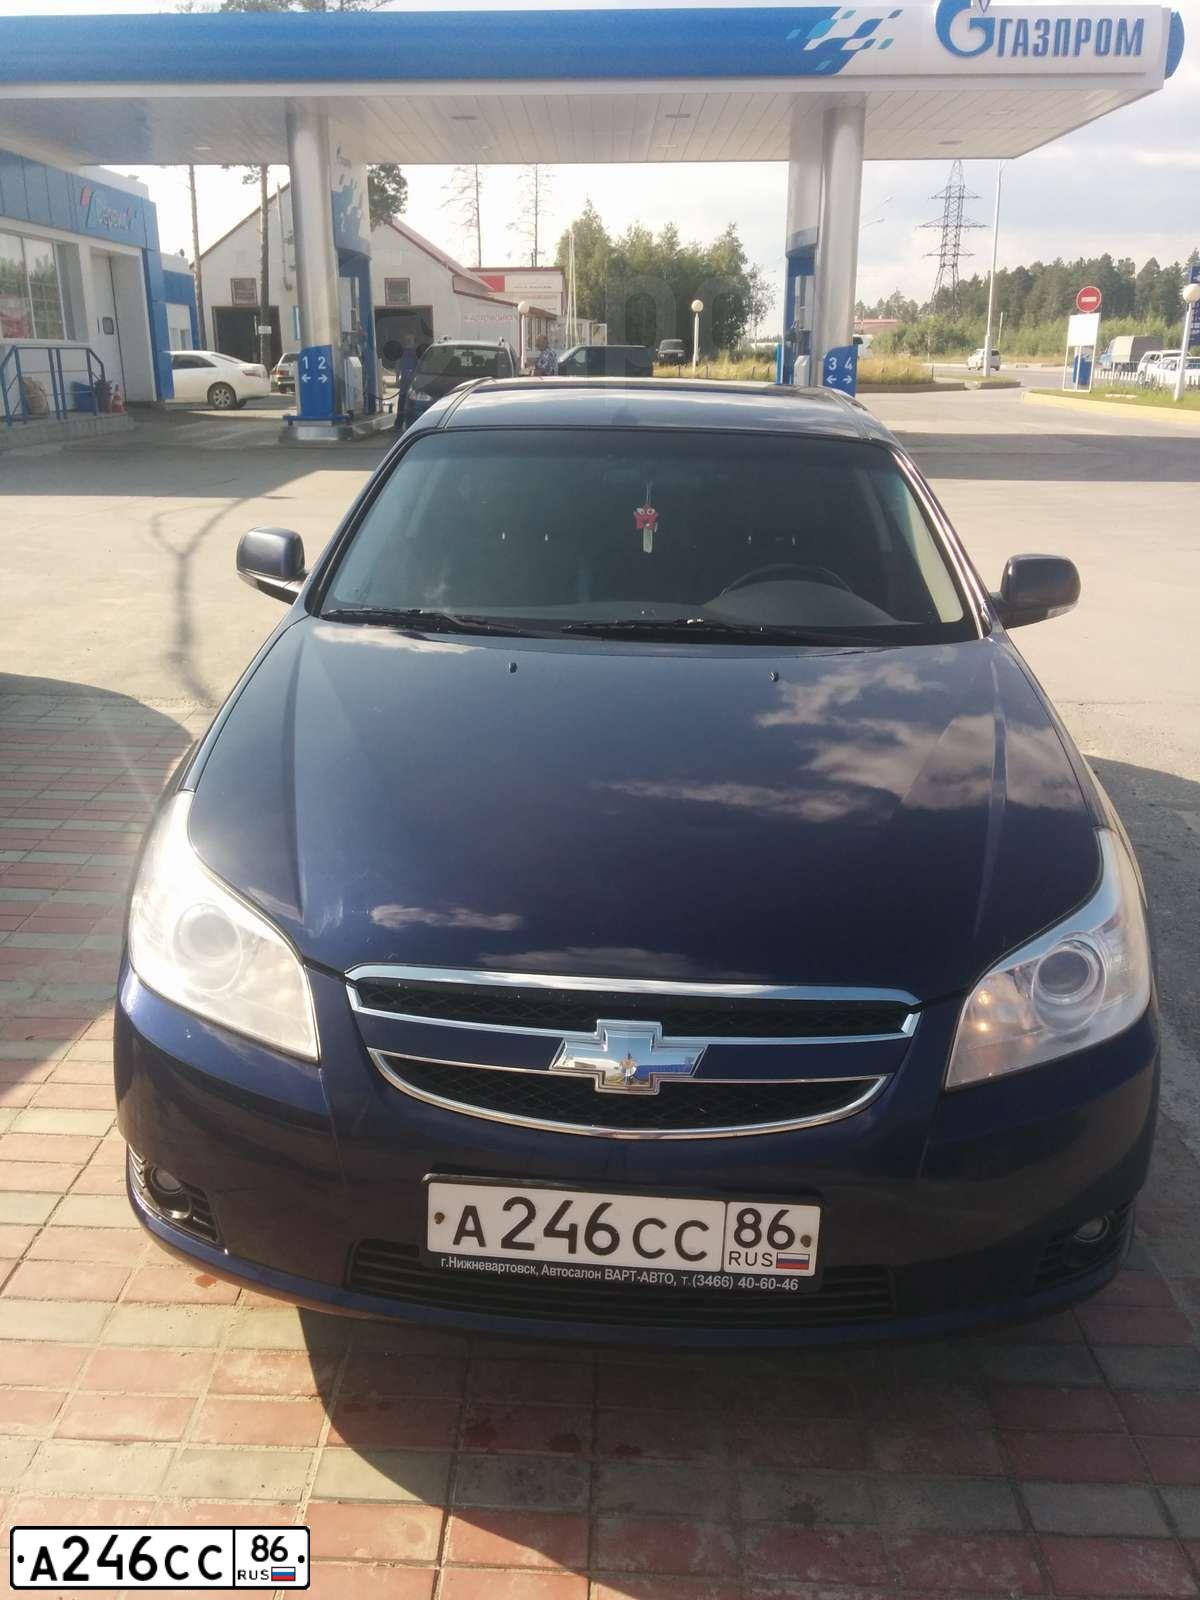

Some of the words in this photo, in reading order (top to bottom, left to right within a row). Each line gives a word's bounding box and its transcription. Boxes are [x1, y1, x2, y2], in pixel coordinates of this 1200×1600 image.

[997, 18, 1146, 57] ГАЗПРОМ
[302, 356, 309, 370] 1
[318, 356, 327, 370] 2
[828, 357, 838, 371] 3
[844, 356, 853, 371] 4
[452, 1196, 710, 1262] А246СС
[733, 1207, 797, 1250] 86
[728, 1250, 773, 1268] RUS
[541, 1264, 601, 1280] Автосалон
[604, 1269, 677, 1286] ВАРТ-АВТО,
[738, 1277, 799, 1291] 40-60-46
